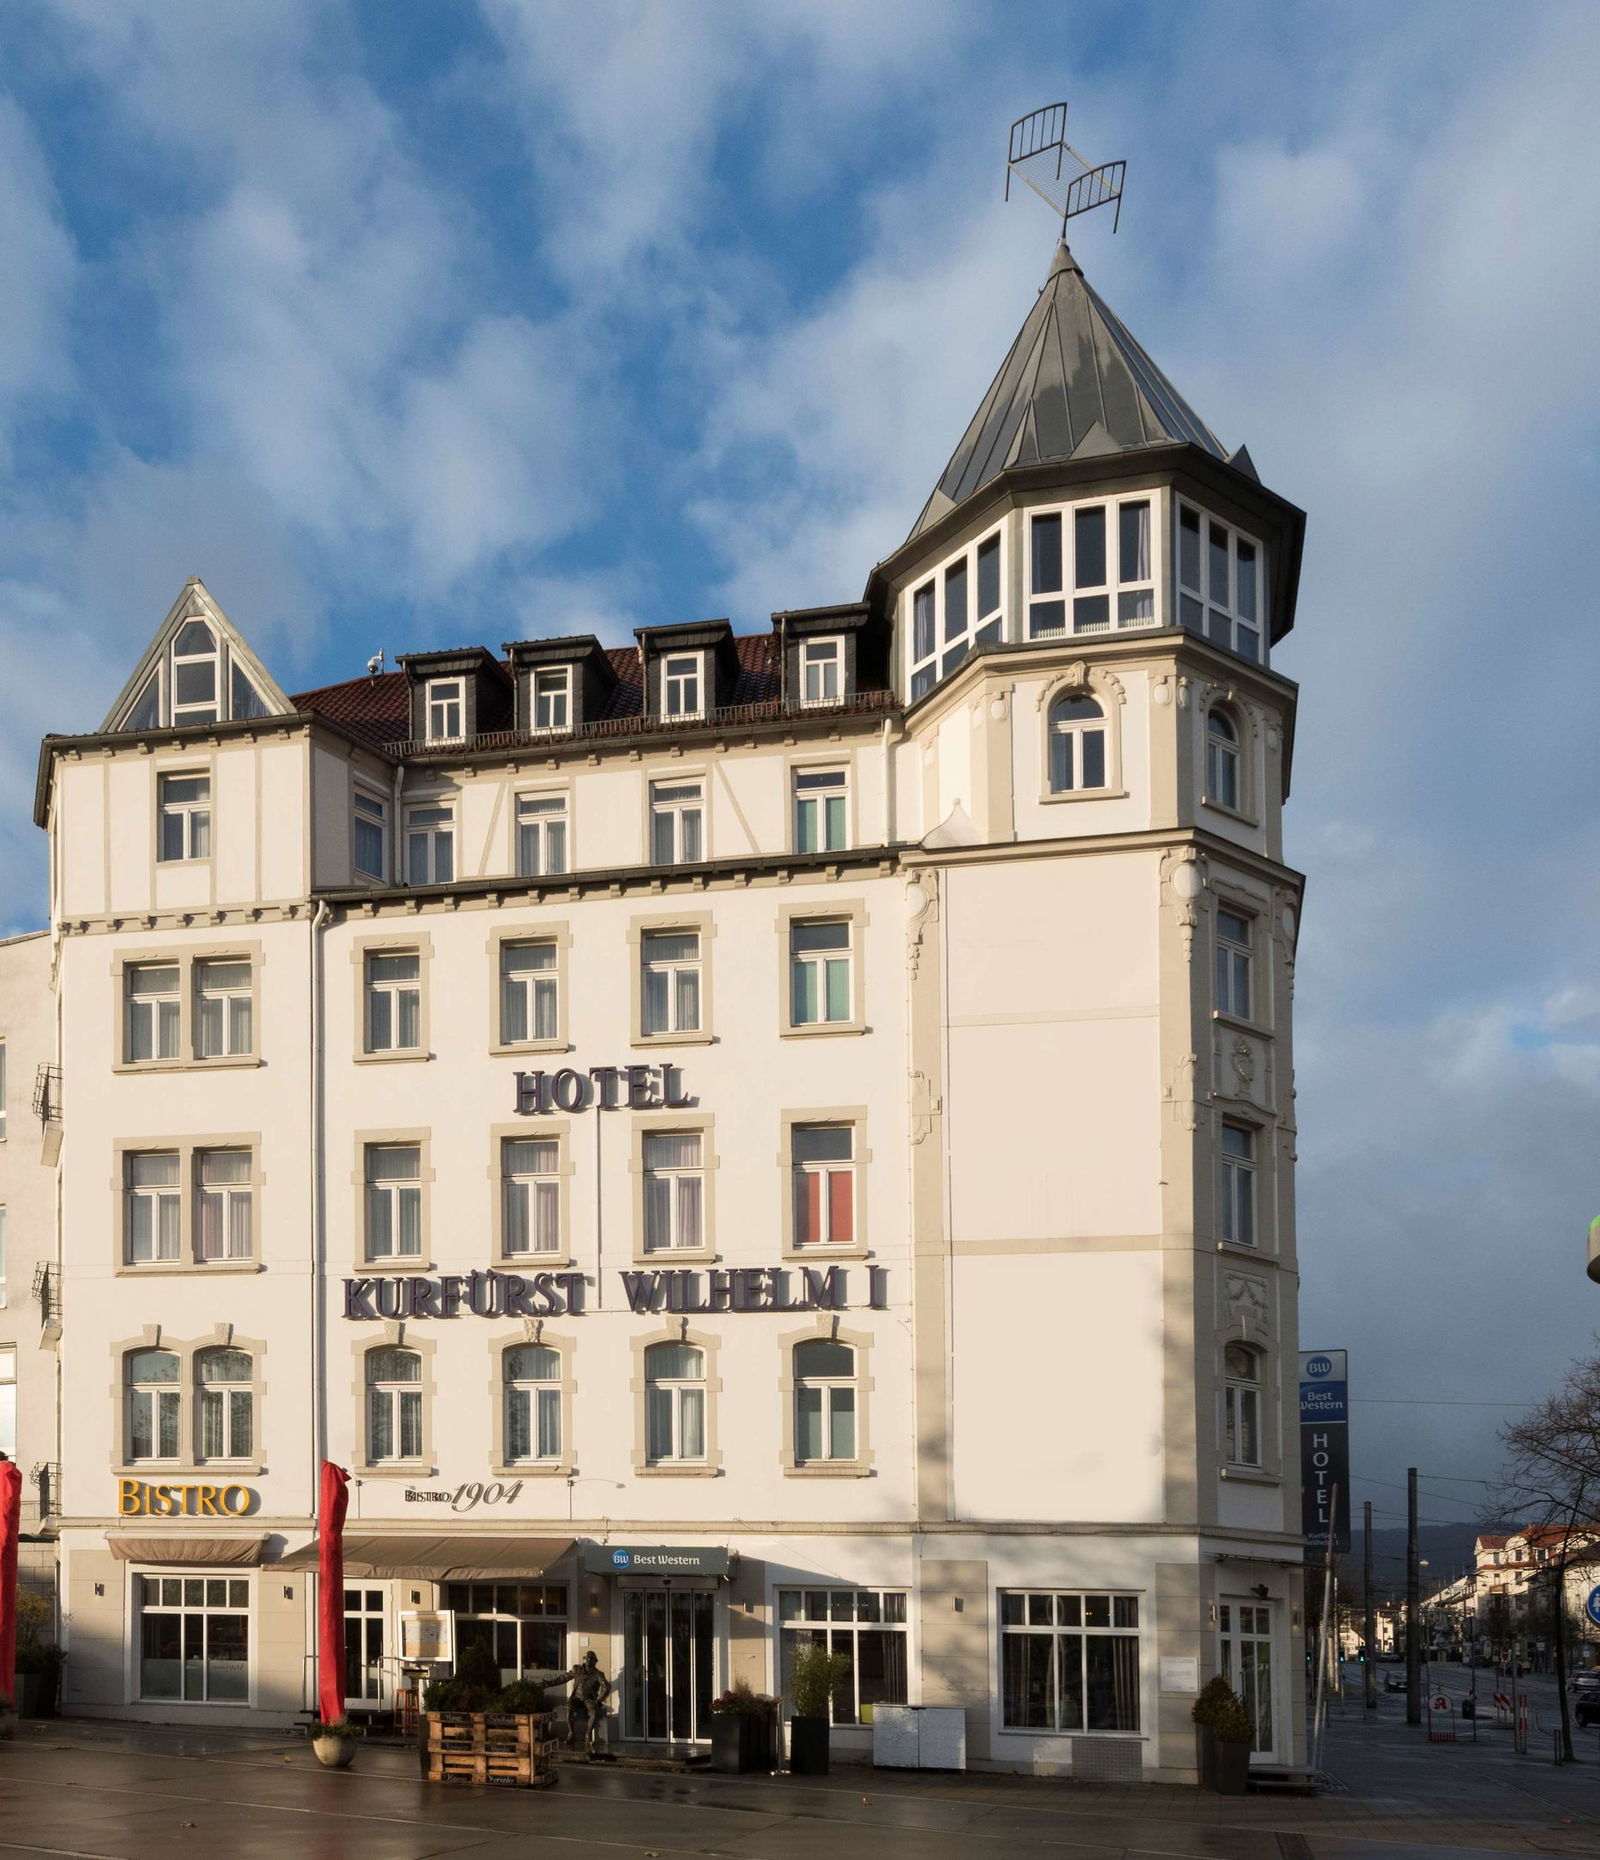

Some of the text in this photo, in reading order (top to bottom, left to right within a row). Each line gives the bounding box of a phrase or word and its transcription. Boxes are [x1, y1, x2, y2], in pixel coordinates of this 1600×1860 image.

[513, 1063, 689, 1114] HOTEL
[341, 1265, 880, 1319] KURFÜRST WILHELM I
[1309, 1362, 1330, 1373] BW
[1307, 1391, 1333, 1401] Best
[1312, 1432, 1329, 1523] HOTEL
[118, 1478, 250, 1515] BISTRO
[451, 1479, 524, 1513] 1904
[613, 1554, 700, 1565] BW Best Western
